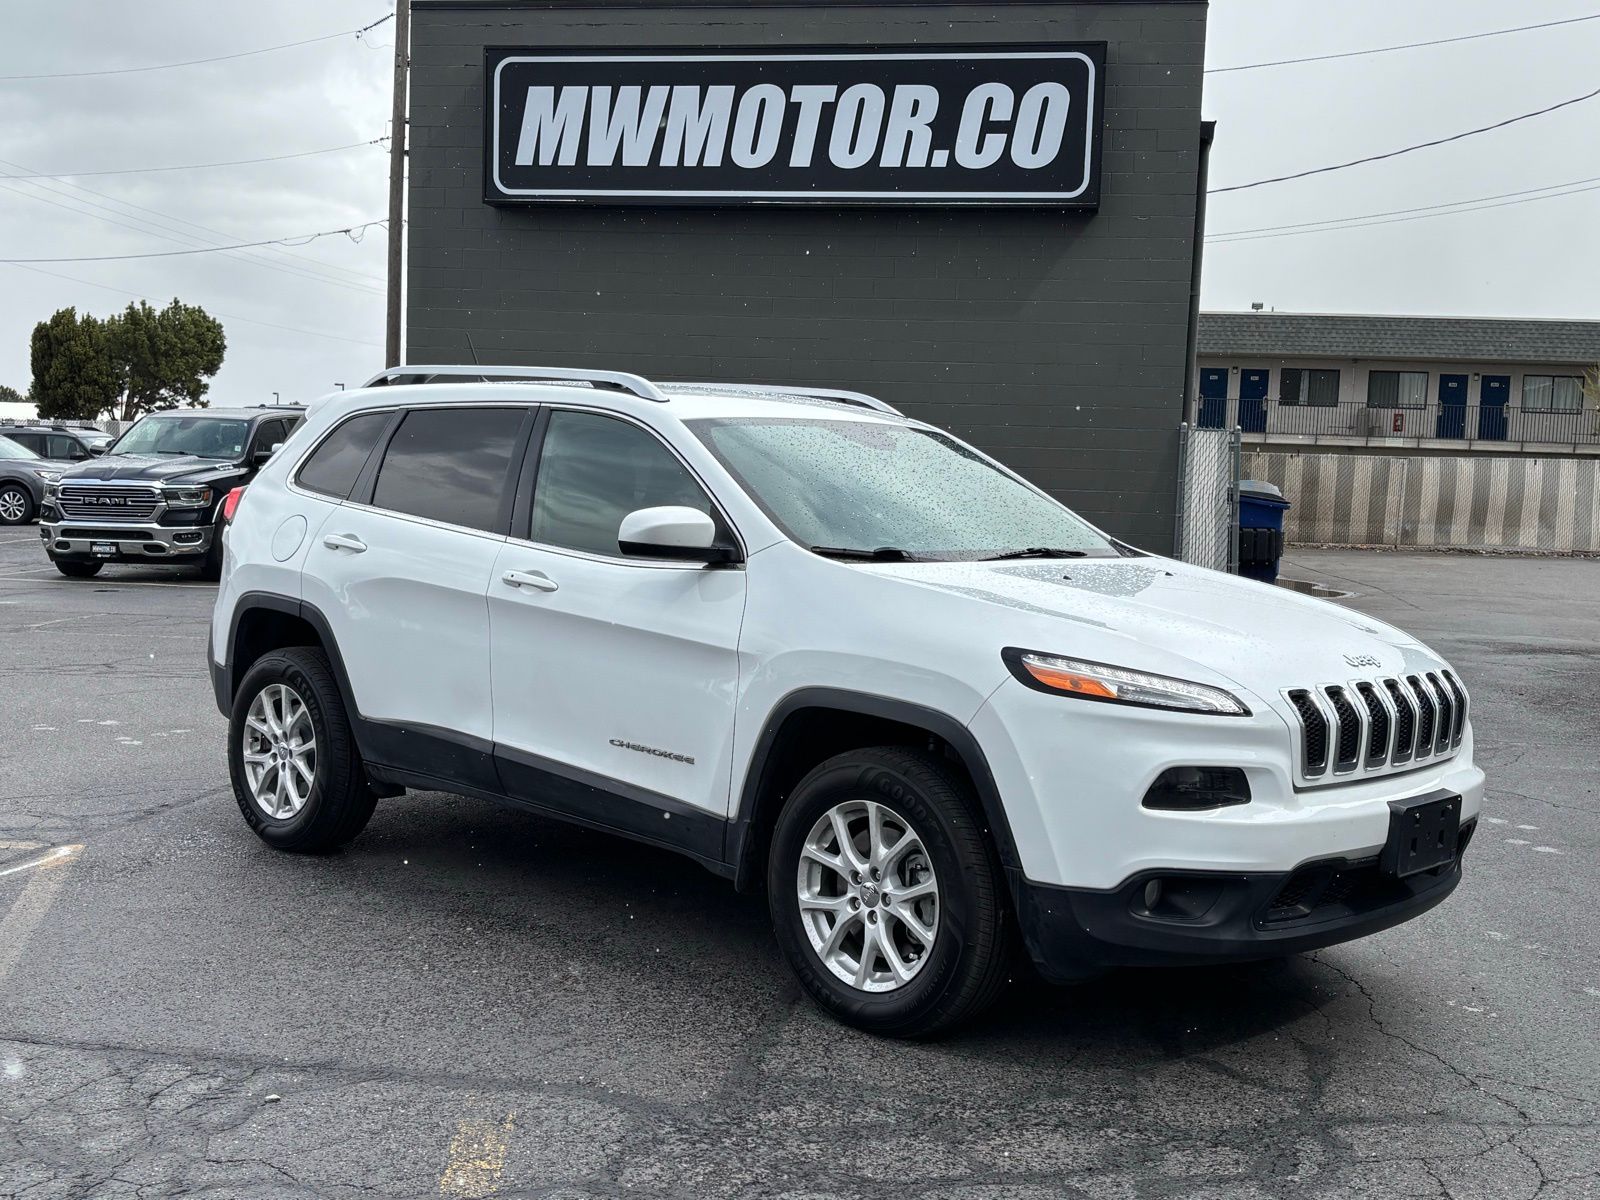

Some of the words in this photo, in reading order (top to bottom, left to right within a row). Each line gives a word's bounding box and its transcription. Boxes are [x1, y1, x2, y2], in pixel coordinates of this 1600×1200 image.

[515, 81, 1071, 169] MWMOTOR.CO
[85, 497, 125, 505] RAM
[1342, 653, 1382, 668] Jeep
[609, 739, 695, 765] CHEROKEE
